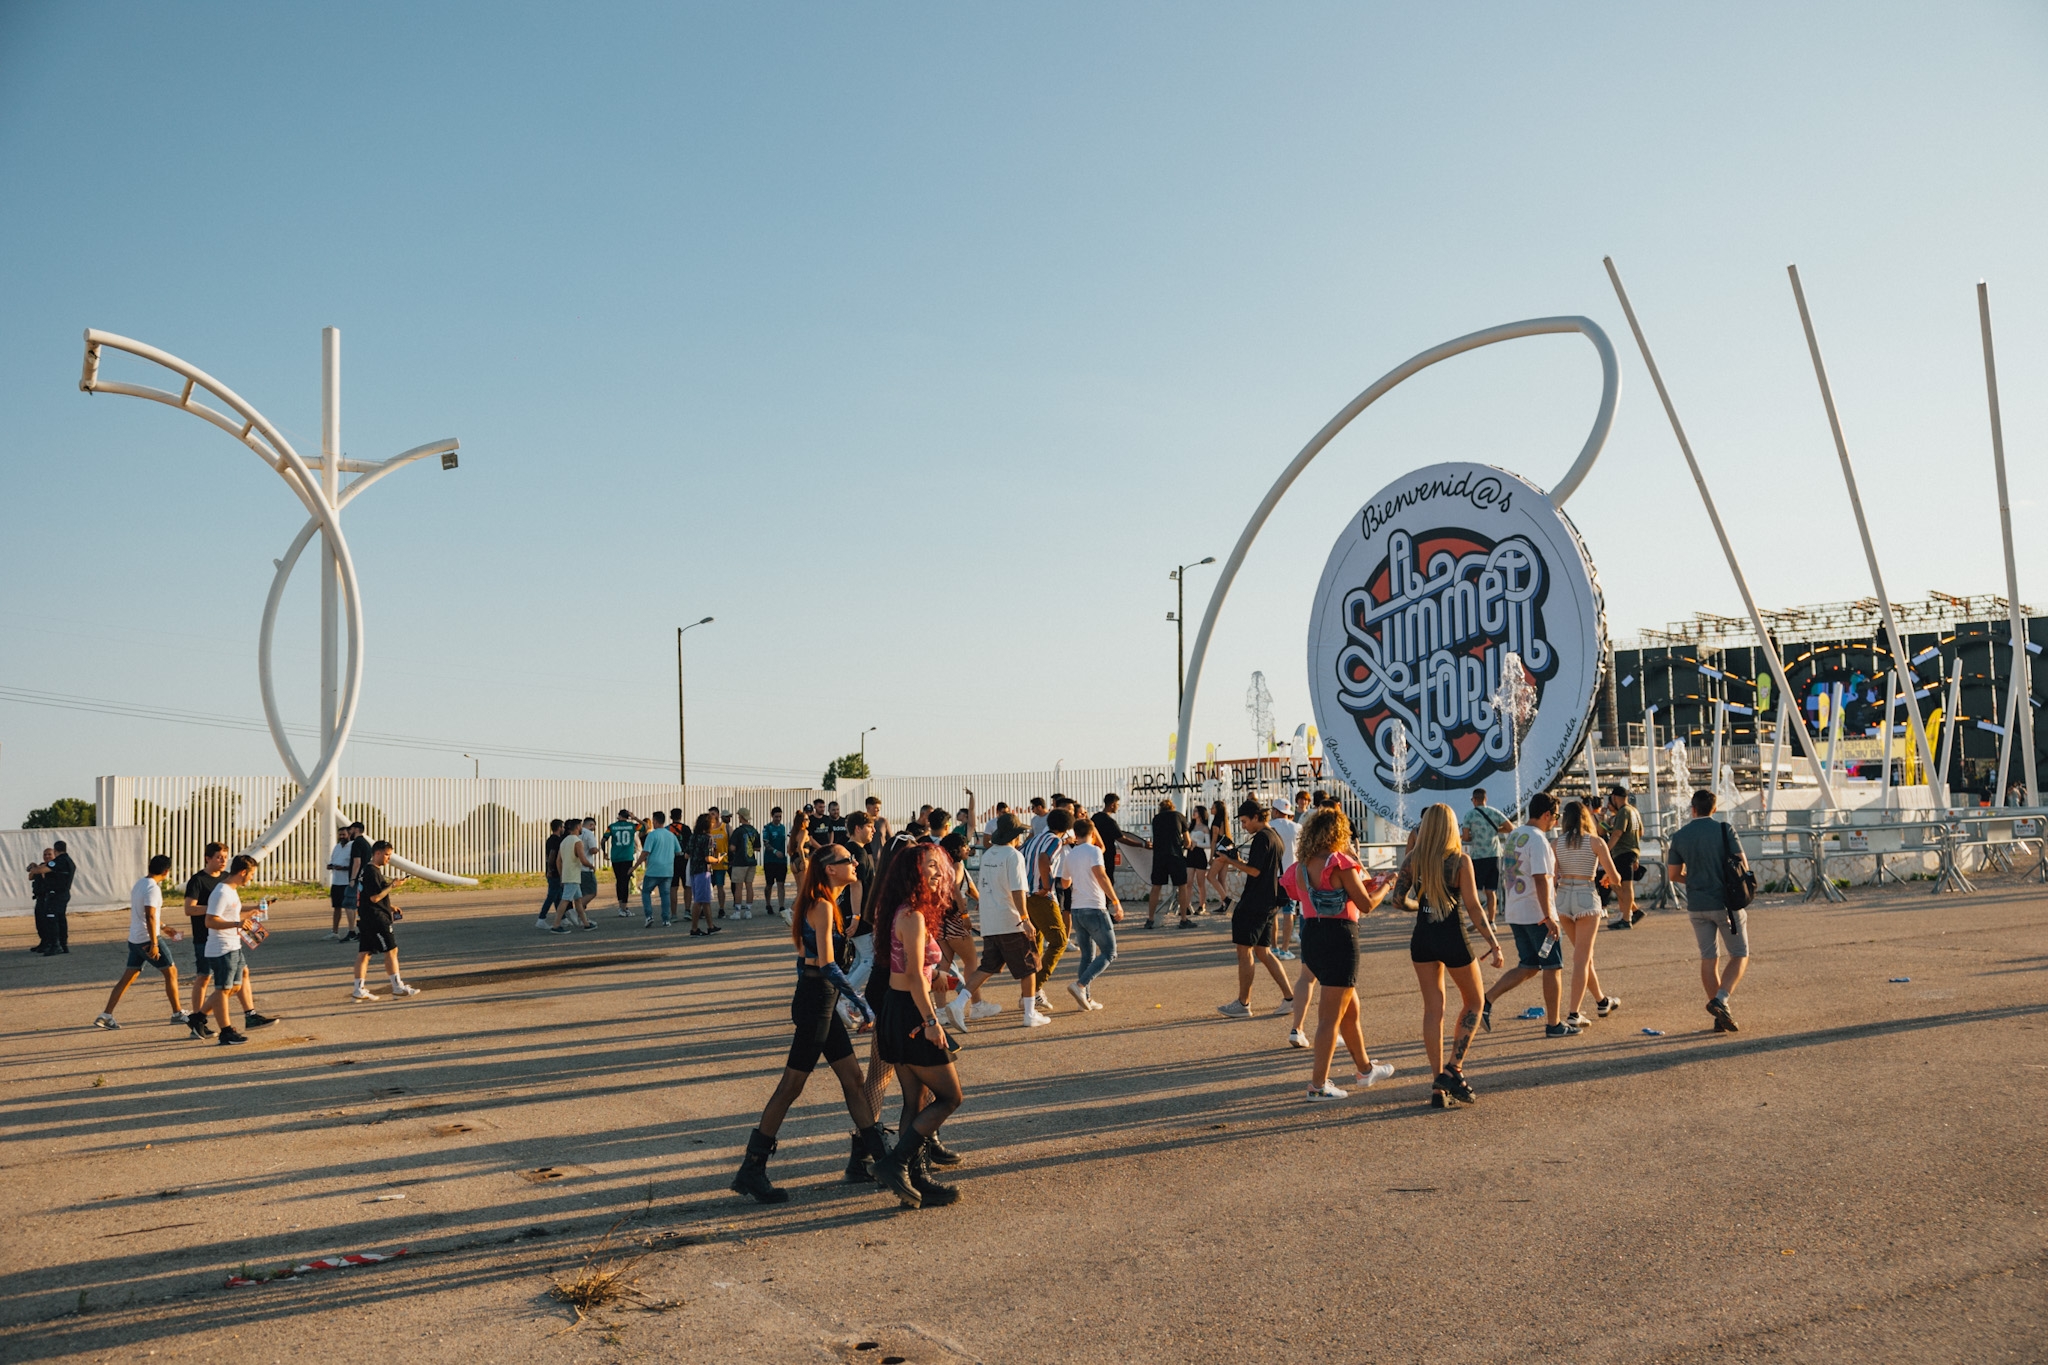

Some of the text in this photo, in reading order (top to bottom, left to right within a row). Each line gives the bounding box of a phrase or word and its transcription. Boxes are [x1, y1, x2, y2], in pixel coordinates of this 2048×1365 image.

[1361, 471, 1514, 541] Bienvenid@s
[1280, 763, 1323, 788] REY
[1533, 775, 1546, 789] en
[1545, 717, 1577, 777] Arganda
[615, 830, 631, 847] 10
